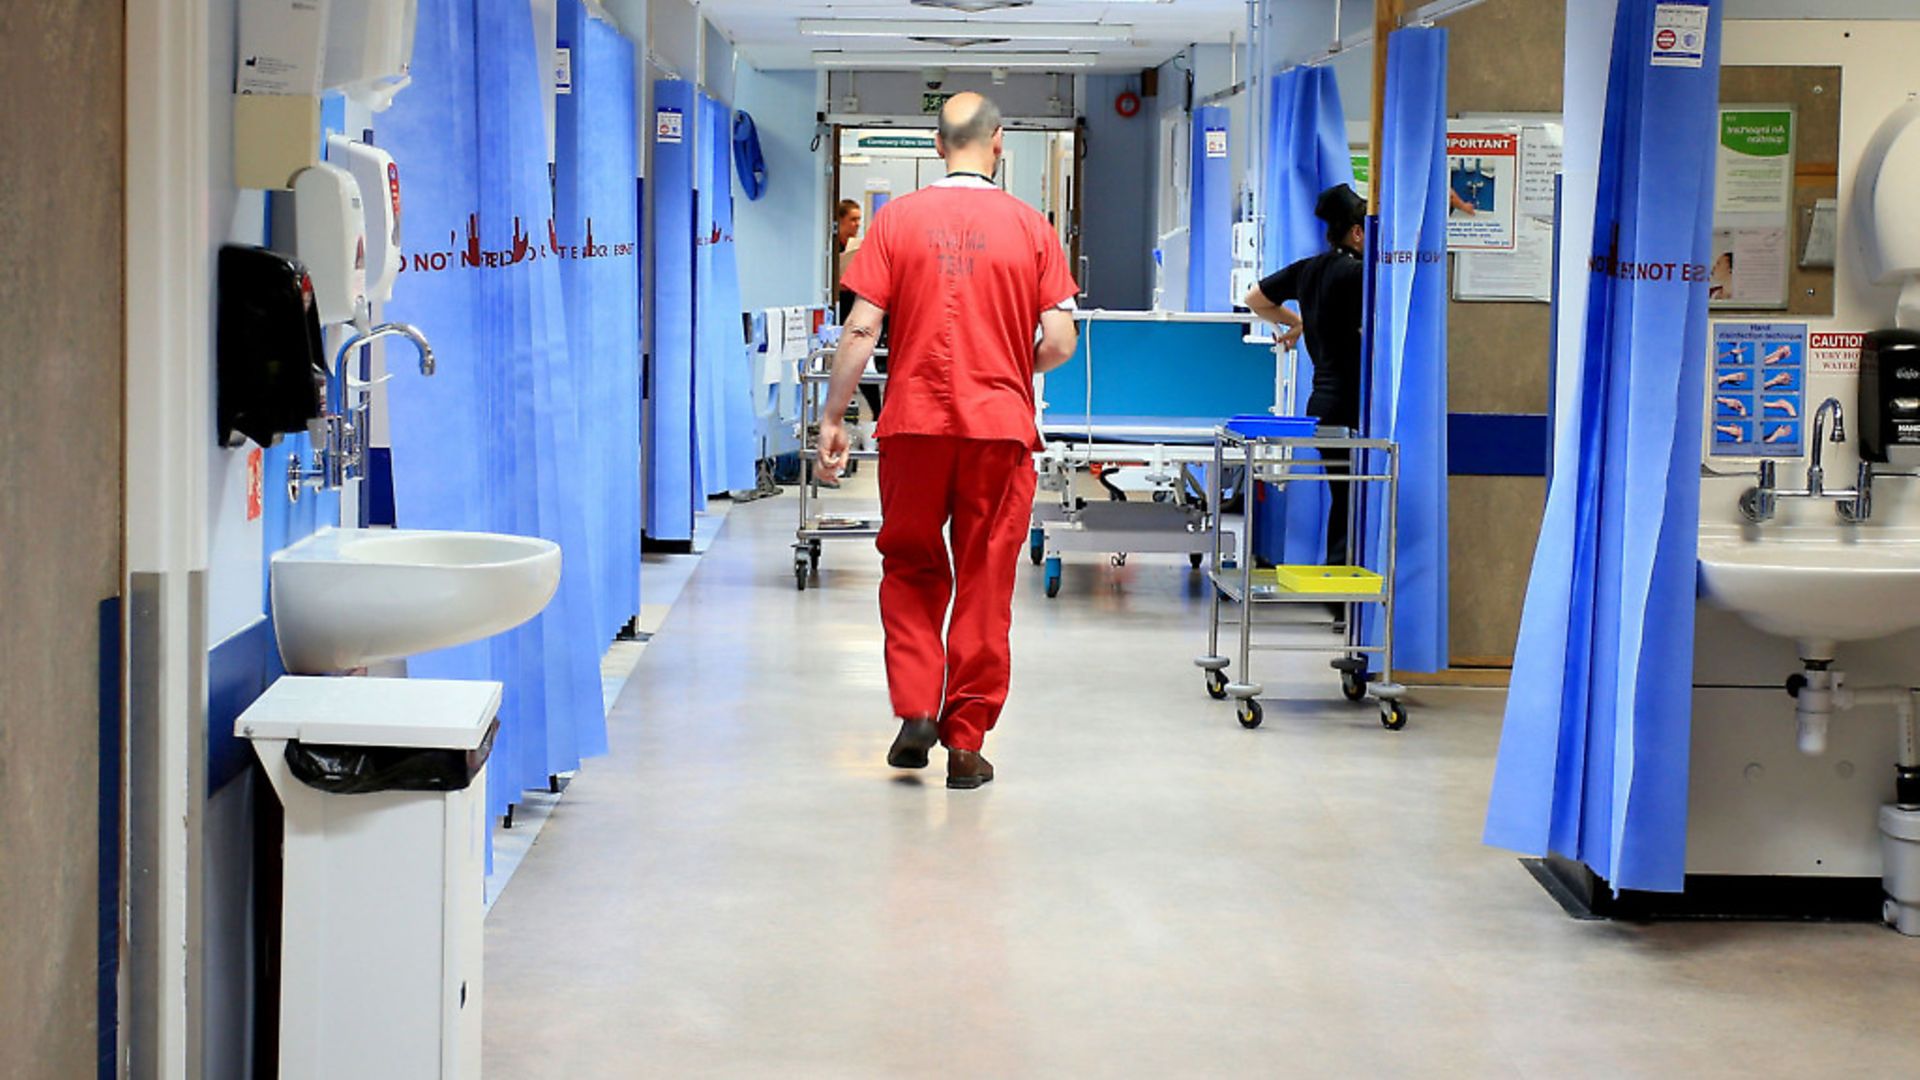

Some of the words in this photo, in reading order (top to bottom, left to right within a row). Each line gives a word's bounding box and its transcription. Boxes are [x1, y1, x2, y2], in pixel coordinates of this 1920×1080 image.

[1447, 138, 1510, 149] PORTANT
[1638, 262, 1676, 281] NOT
[1815, 351, 1840, 359] VERY
[1844, 351, 1862, 359] HO
[1823, 362, 1857, 370] WATER
